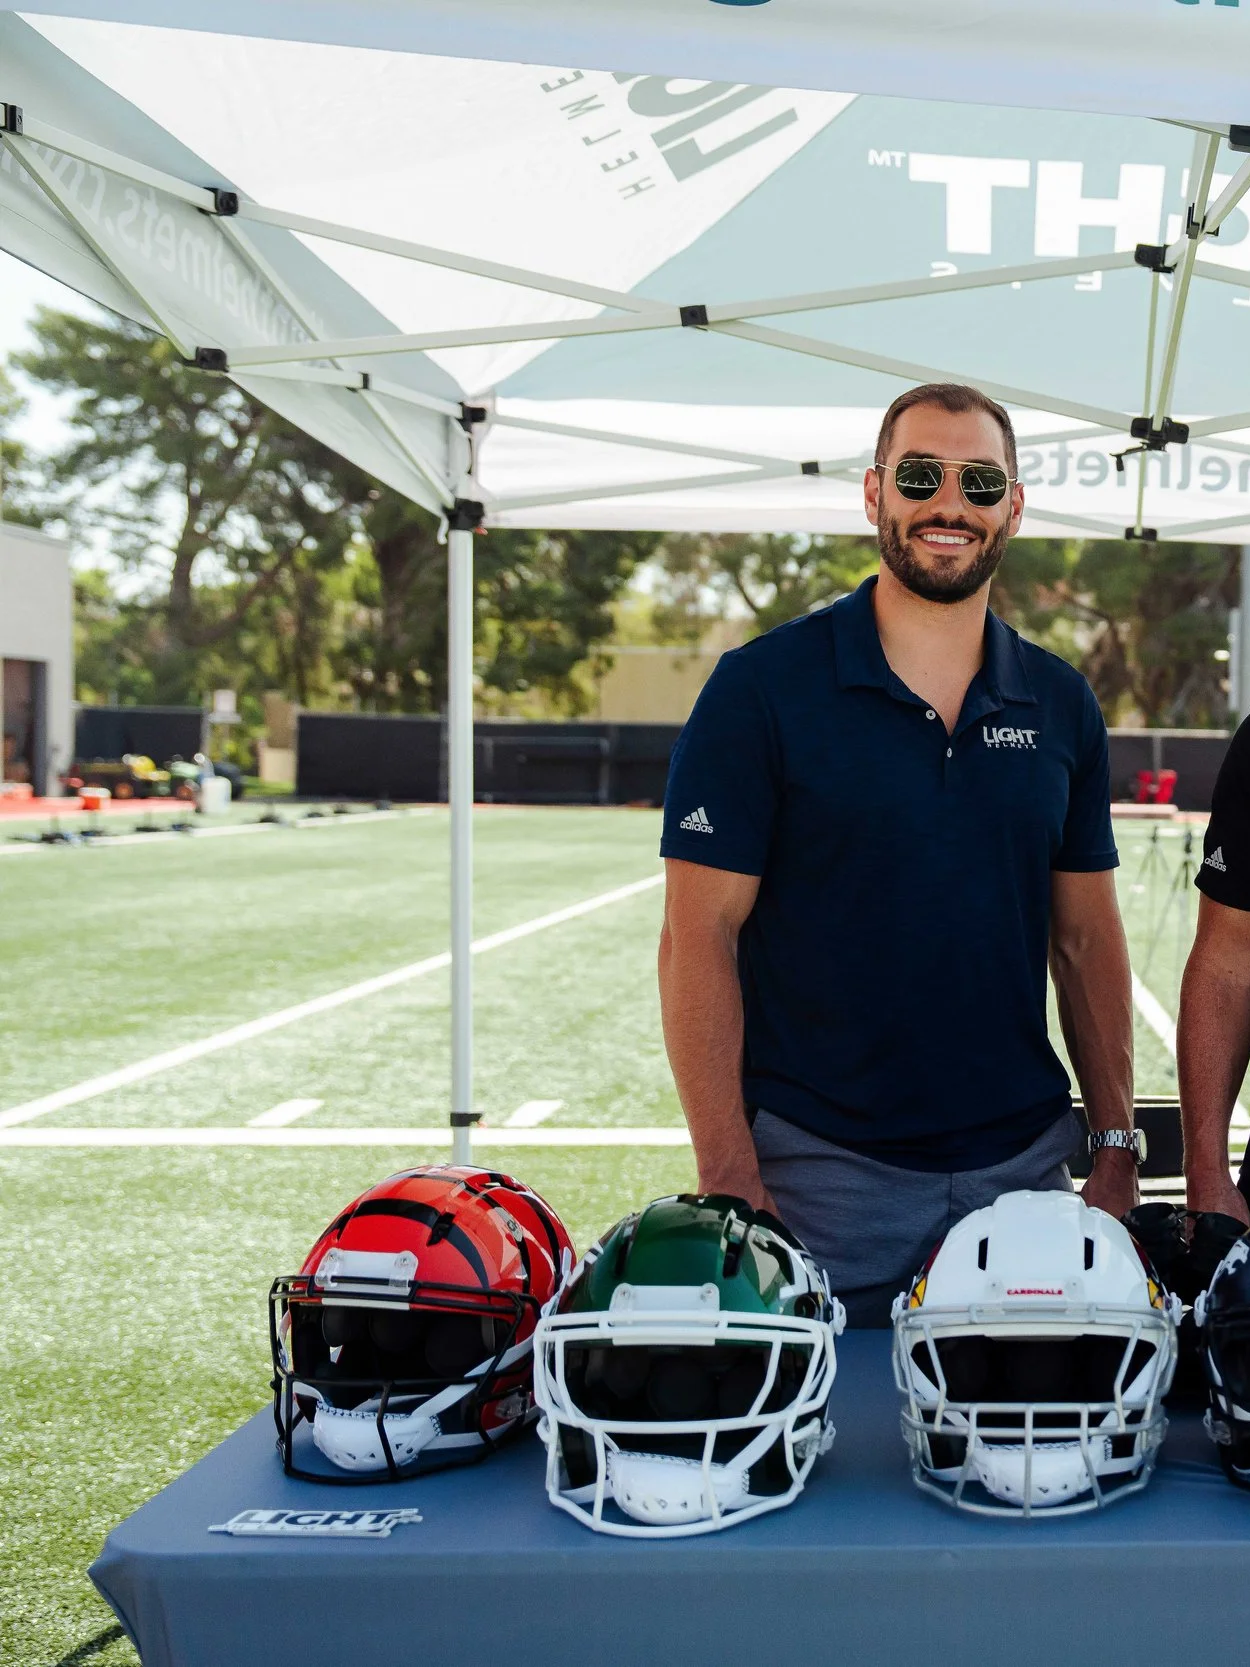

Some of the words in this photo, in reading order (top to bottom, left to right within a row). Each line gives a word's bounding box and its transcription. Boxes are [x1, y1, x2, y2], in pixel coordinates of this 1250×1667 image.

[983, 726, 1036, 744] LIGHT
[680, 820, 714, 834] adidas
[1006, 1288, 1063, 1296] CARDINALS
[233, 1509, 396, 1526] LIGHT
